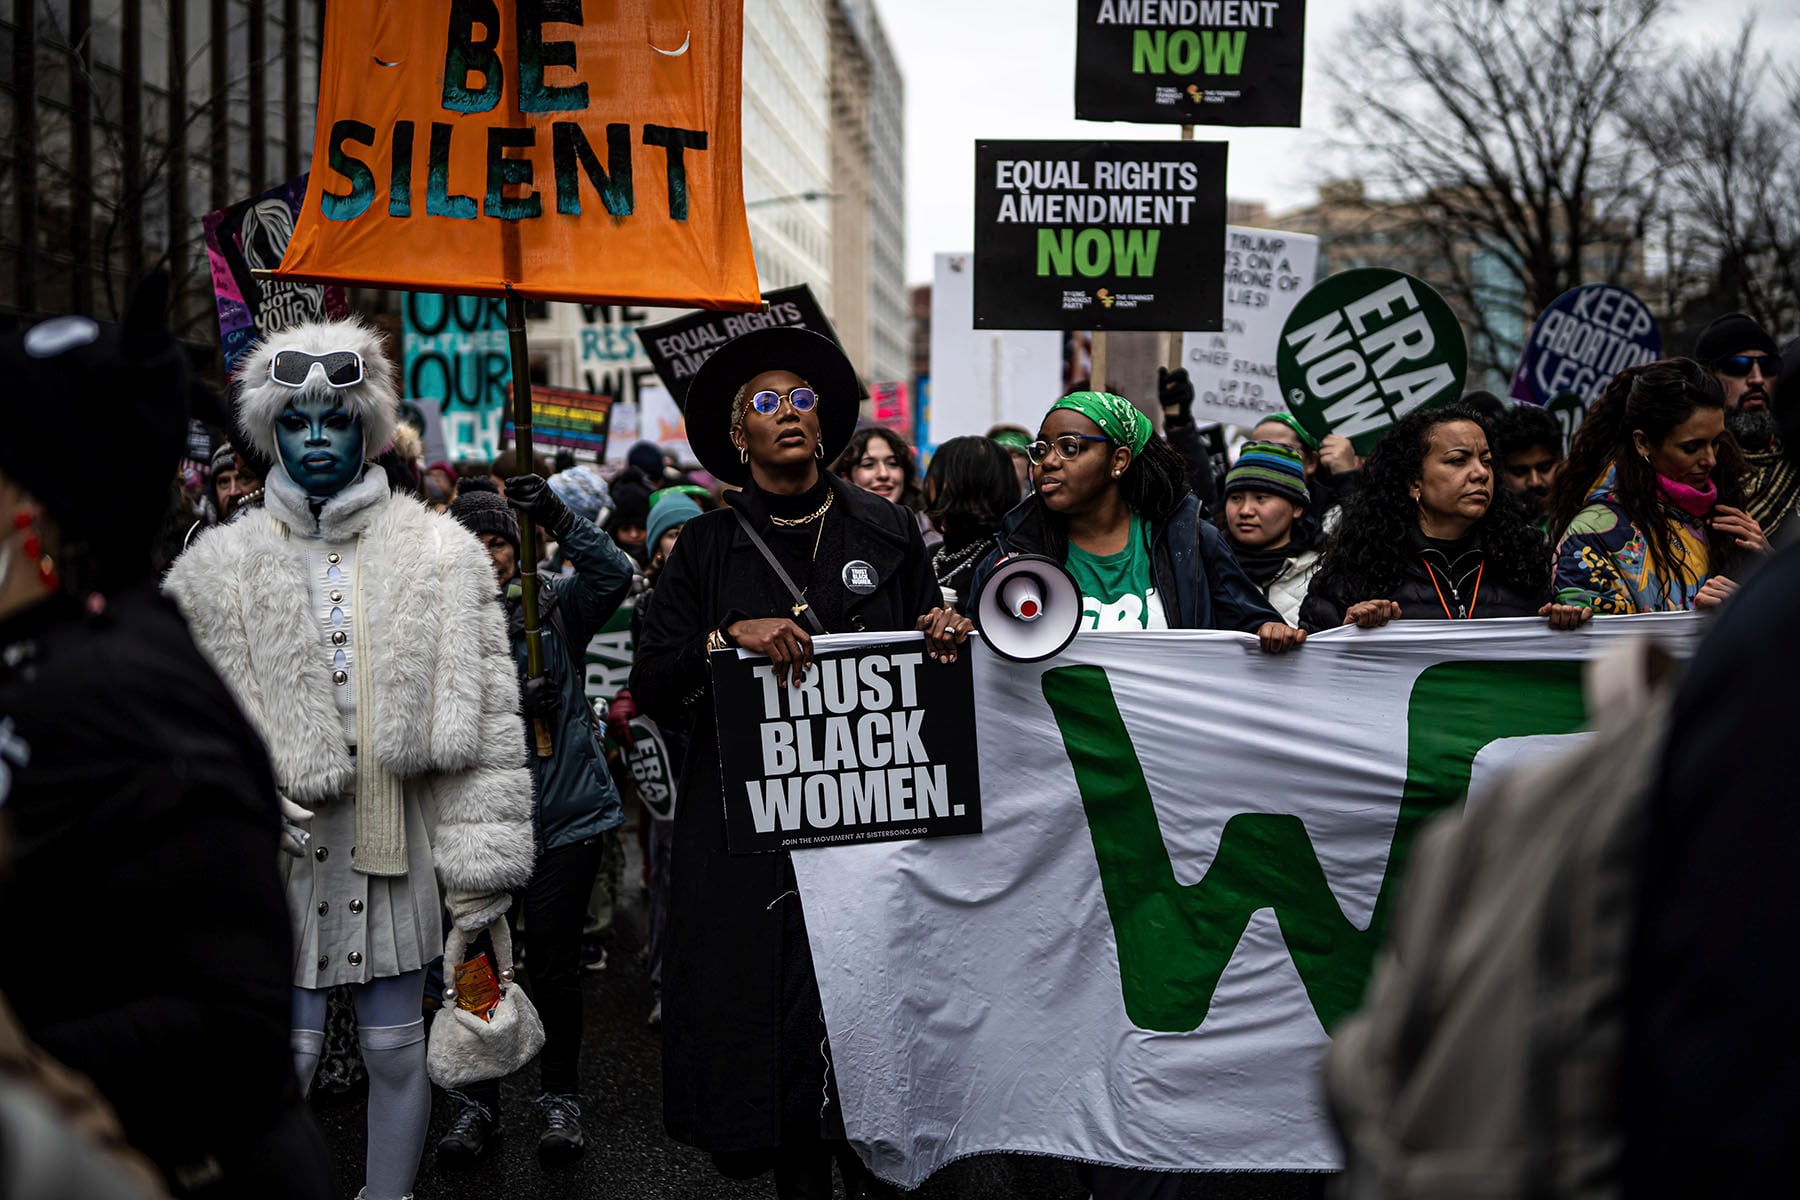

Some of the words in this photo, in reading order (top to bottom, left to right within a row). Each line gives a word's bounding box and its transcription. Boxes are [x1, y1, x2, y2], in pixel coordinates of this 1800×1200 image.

[1096, 0, 1280, 27] AMENDMENT
[442, 0, 589, 114] BE
[1131, 29, 1248, 76] NOW
[321, 120, 708, 222] SILENT
[996, 160, 1089, 194] EQUAL
[1094, 160, 1199, 191] RIGHTS
[997, 194, 1197, 225] AMENDMENT
[1036, 228, 1161, 279] NOW
[1230, 233, 1286, 254] TRUMP
[1246, 253, 1273, 270] ON
[1277, 257, 1292, 273] A
[258, 291, 295, 313] NOT
[1278, 275, 1302, 290] OF
[255, 301, 307, 337] YOUR
[655, 321, 729, 360] EQUAL
[722, 301, 804, 337] RIGHTS
[1571, 287, 1653, 340] KEEP
[1190, 347, 1231, 365] CHIEF
[1343, 276, 1457, 422] ERA
[1535, 308, 1658, 376] ABORTION
[1242, 380, 1264, 397] TO
[1284, 309, 1394, 440] NOW
[752, 652, 923, 720] TRUST
[759, 709, 930, 776] BLACK
[636, 736, 669, 802] ERA
[745, 763, 966, 833] WOMEN.
[782, 838, 798, 846] JOIN
[799, 836, 812, 844] THE
[813, 834, 854, 843] MOVEMENT
